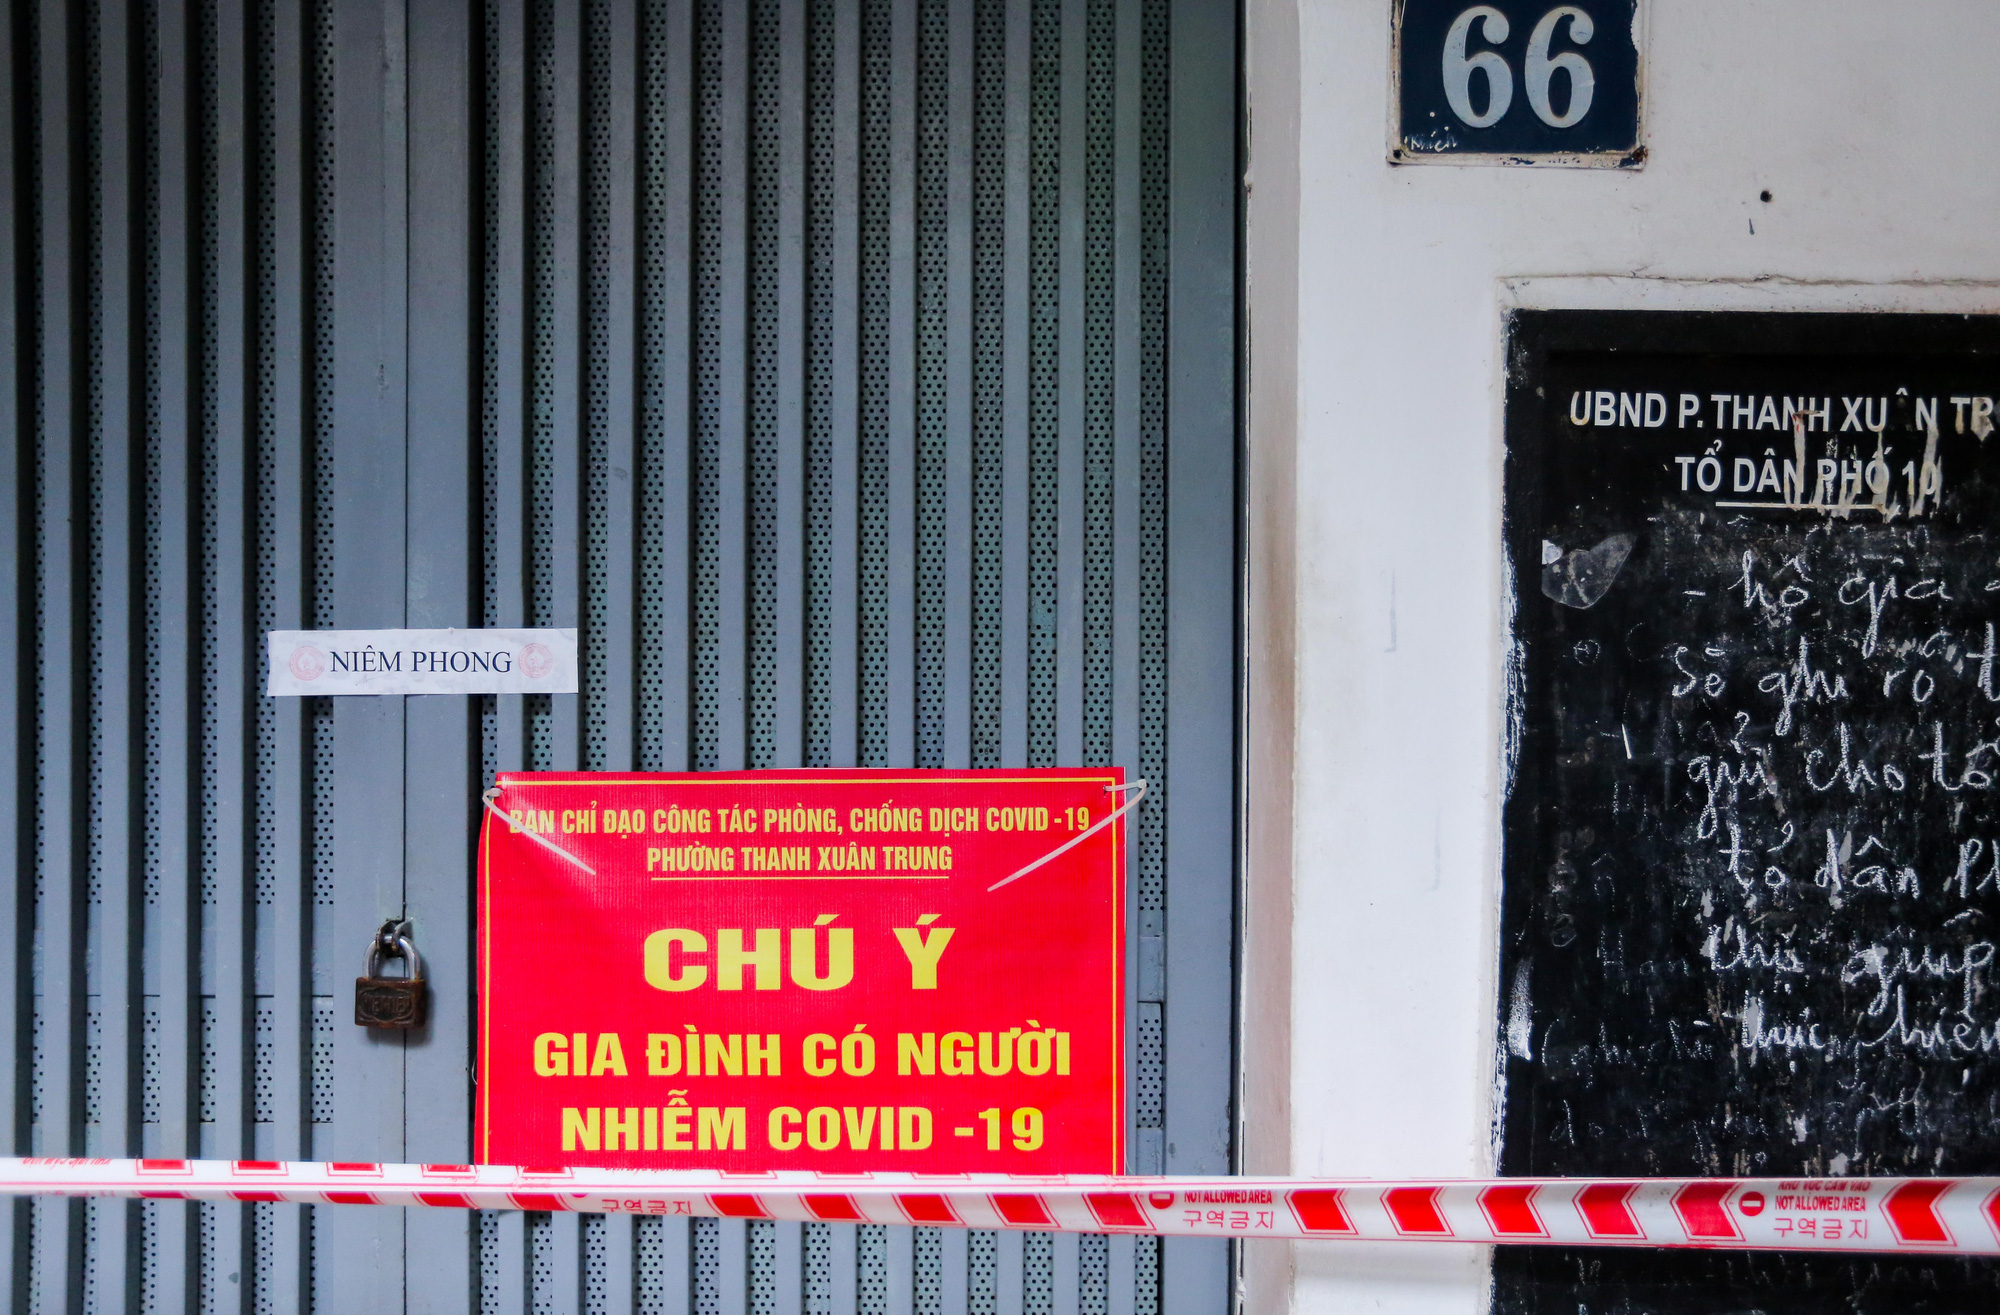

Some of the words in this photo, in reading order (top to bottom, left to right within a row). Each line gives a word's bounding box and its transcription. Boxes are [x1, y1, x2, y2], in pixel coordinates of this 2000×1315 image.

[1442, 6, 1595, 128] 66
[1570, 391, 1667, 428] UBND
[1839, 388, 1938, 432] XUN
[1675, 440, 1722, 492] TỔ
[1733, 448, 1805, 494] DÂN
[1816, 447, 1890, 495] PHỐ
[330, 645, 401, 673] NIÊM
[411, 650, 512, 673] PHONG
[510, 810, 555, 834] BAN
[562, 800, 598, 834] CHỈ
[603, 808, 646, 839] ĐẠO
[653, 804, 709, 834] CÔNG
[717, 804, 757, 833] TÁC
[765, 803, 843, 835] PHÒNG,
[850, 799, 923, 832] CHỐNG
[929, 807, 979, 838] DỊCH
[986, 807, 1049, 832] COVID
[647, 841, 734, 872] PHƯỜNG
[741, 847, 811, 871] THANH
[818, 842, 876, 871] XUÂN
[882, 846, 952, 870] TRUNG
[643, 914, 854, 993] CHÚ
[892, 914, 956, 990] Ý
[533, 1032, 628, 1076] GIA
[646, 1024, 781, 1076] ĐÌNH
[802, 1023, 876, 1077] CÓ
[897, 1019, 1070, 1076] NGƯỜI
[561, 1089, 746, 1151] NHIỄM
[768, 1106, 933, 1151] COVID
[602, 1199, 692, 1215] 구역금지
[1203, 1190, 1247, 1204] ALLOWED
[1248, 1190, 1272, 1204] AREA
[1775, 1195, 1794, 1210] NOT
[1795, 1195, 1840, 1211] ALLOWED
[1841, 1196, 1866, 1212] AREA
[1183, 1210, 1274, 1229] 구역금지
[1773, 1217, 1868, 1239] 구역금지
